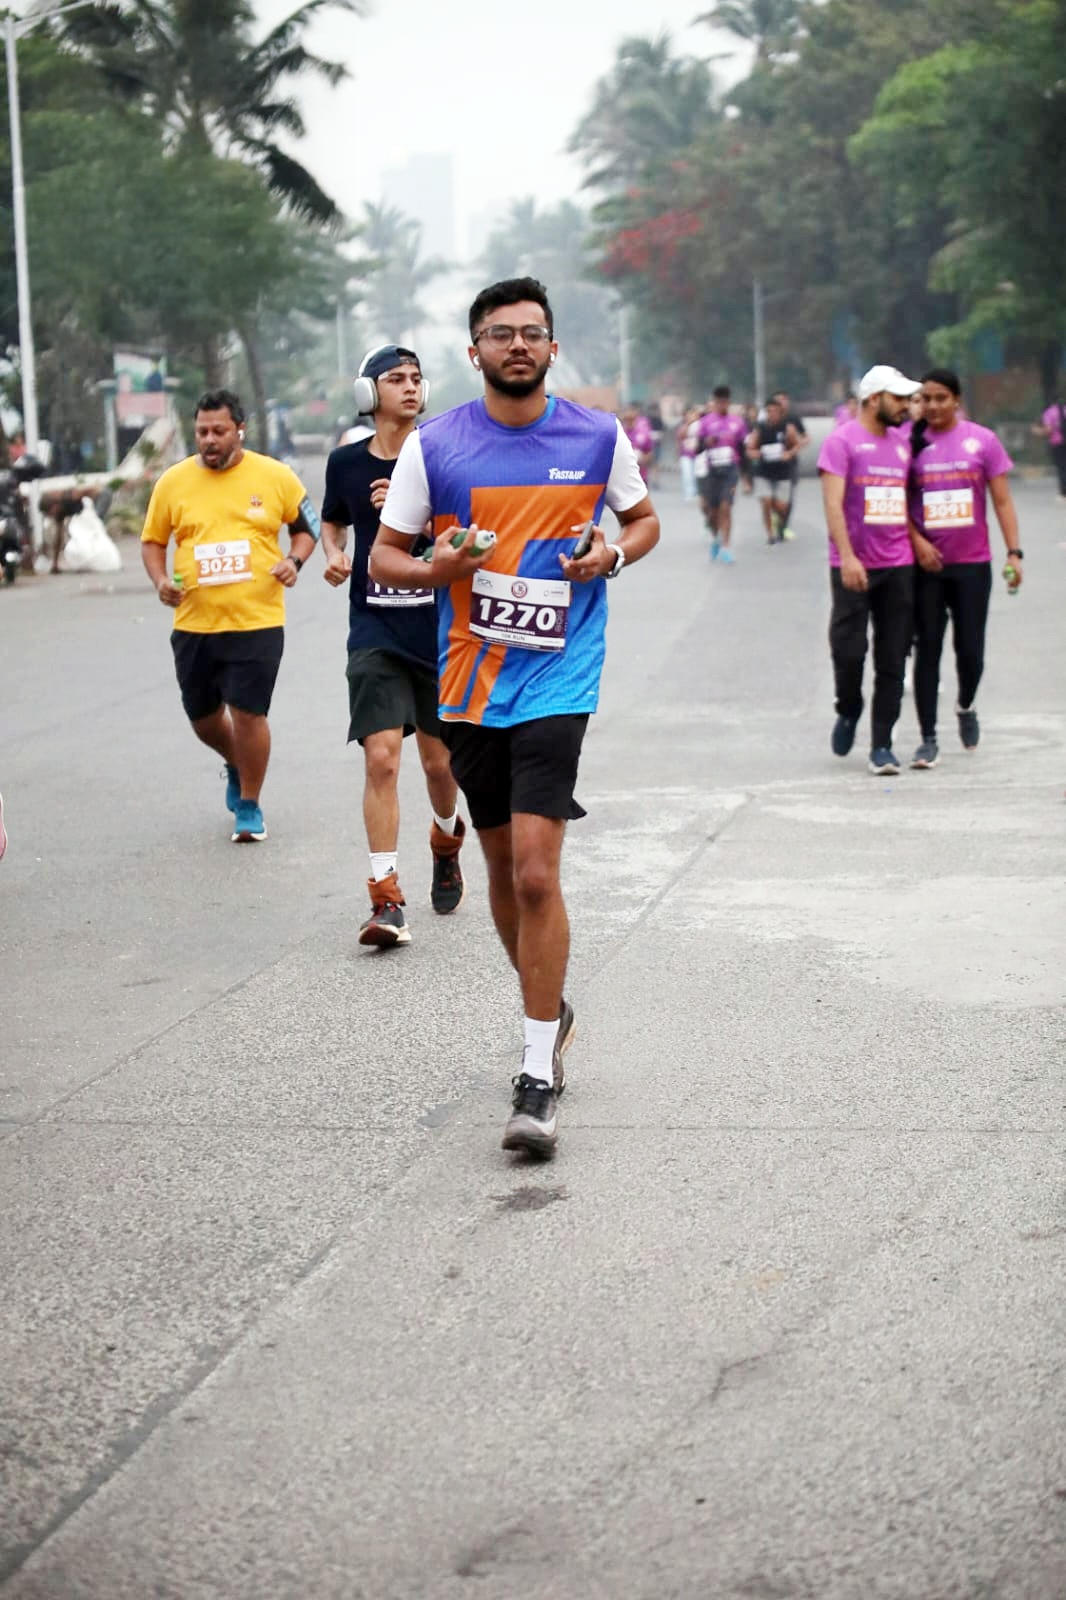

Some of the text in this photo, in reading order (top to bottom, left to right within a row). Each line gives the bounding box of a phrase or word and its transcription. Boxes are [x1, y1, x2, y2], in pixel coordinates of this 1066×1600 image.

[548, 467, 586, 480] FAST&UP
[926, 502, 969, 518] 3091
[200, 556, 246, 574] 3023
[480, 598, 556, 631] 1270
